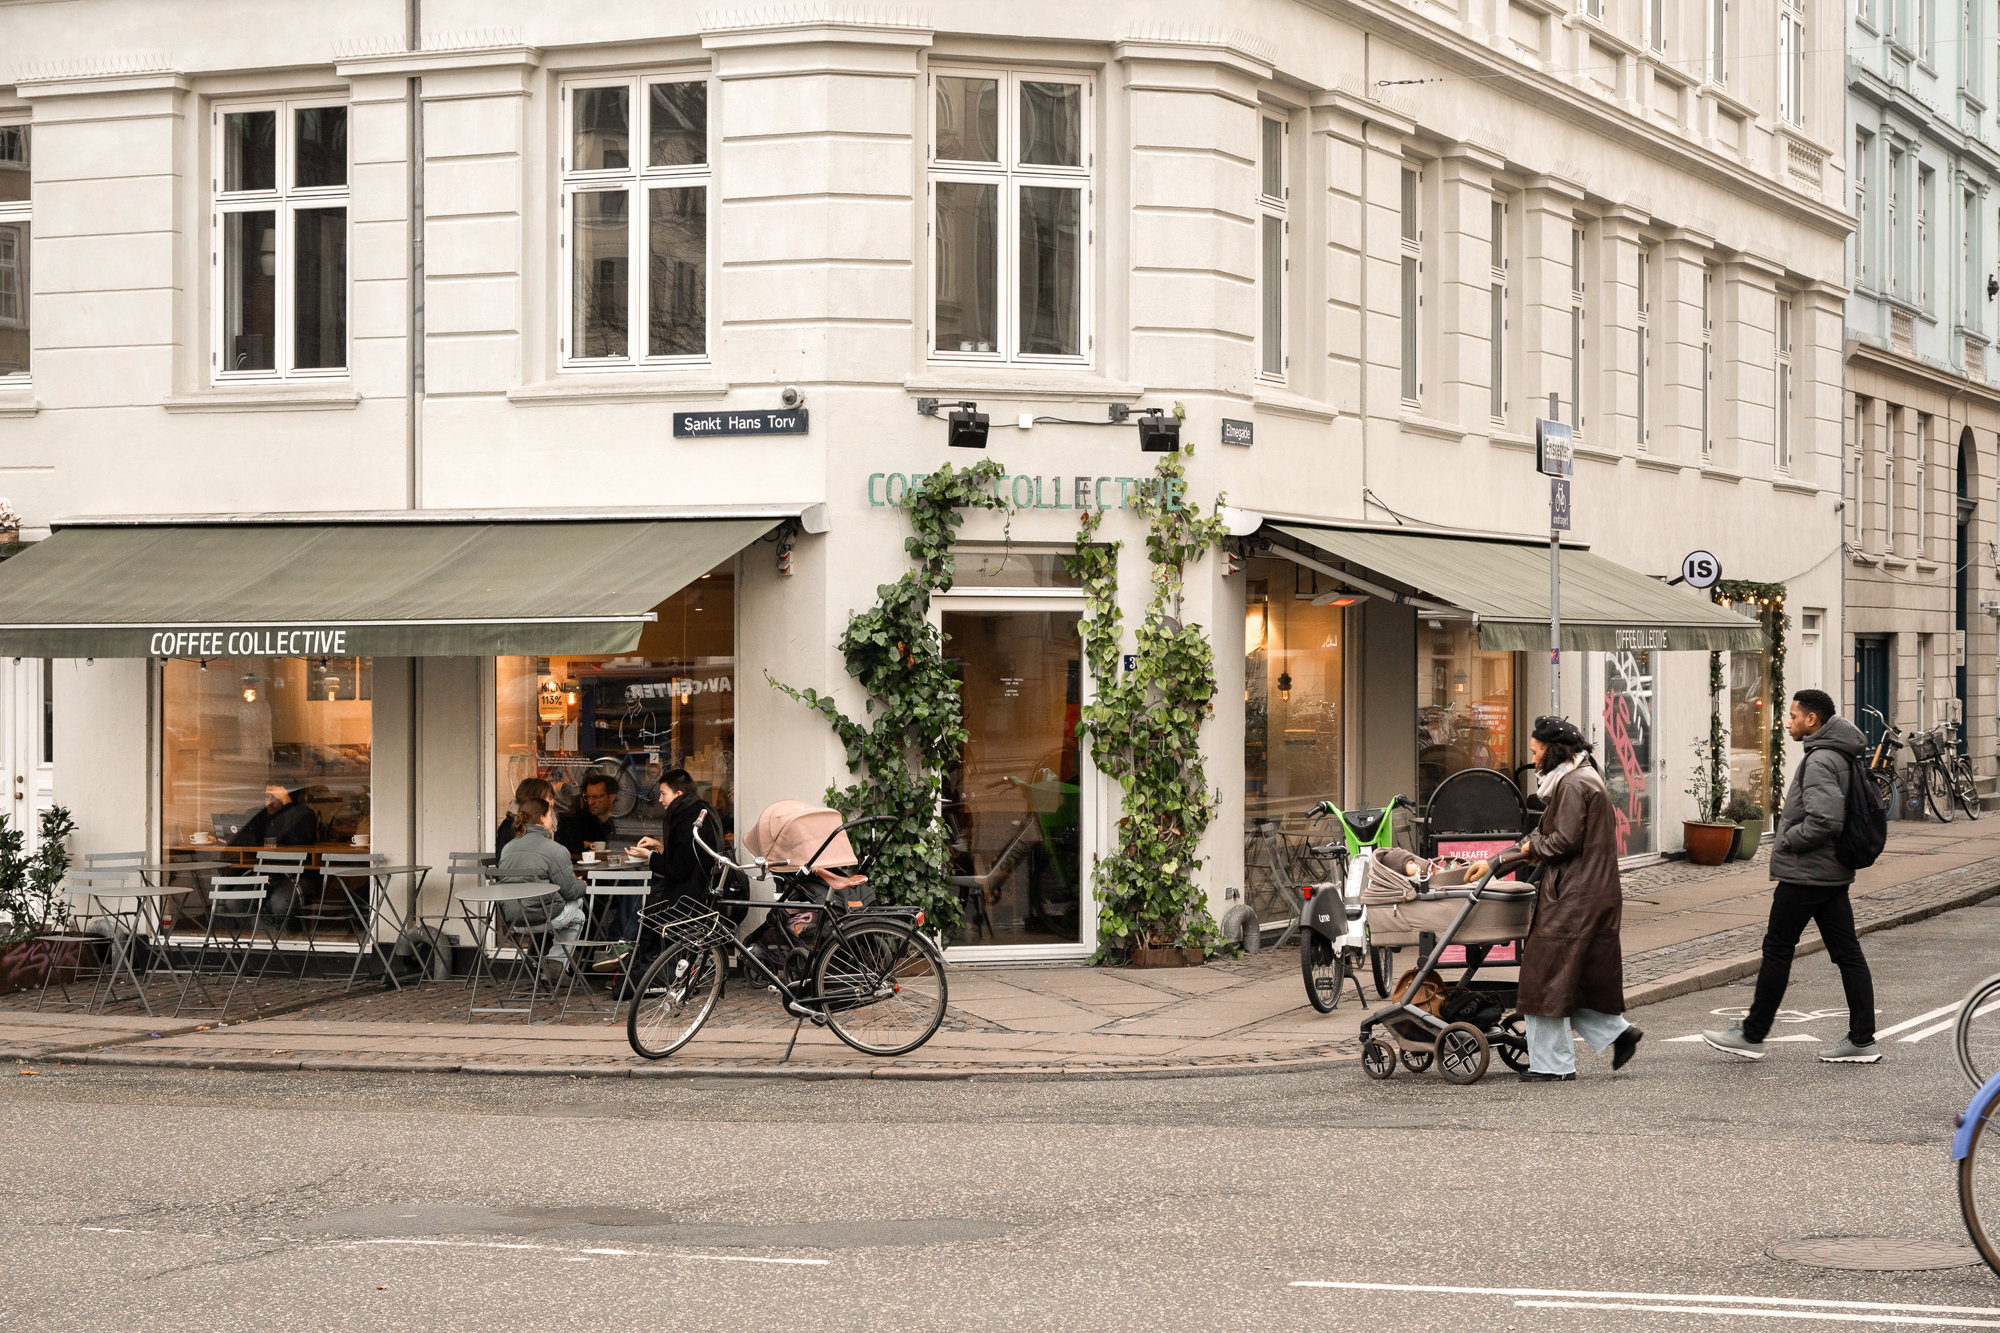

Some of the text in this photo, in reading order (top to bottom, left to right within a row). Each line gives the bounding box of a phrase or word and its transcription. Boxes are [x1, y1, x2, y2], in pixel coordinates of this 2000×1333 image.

[684, 415, 796, 431] Sankt Hans Torv
[1226, 423, 1251, 440] Elmegade
[868, 472, 1184, 511] COF COLLECTIVE
[1688, 560, 1713, 578] IS
[150, 630, 347, 655] COFFEE COLLECTIVE
[1615, 629, 1668, 649] COFFEE COLLECTIVE
[542, 695, 563, 706] 113%
[1450, 850, 1489, 859] JULEKAFFE
